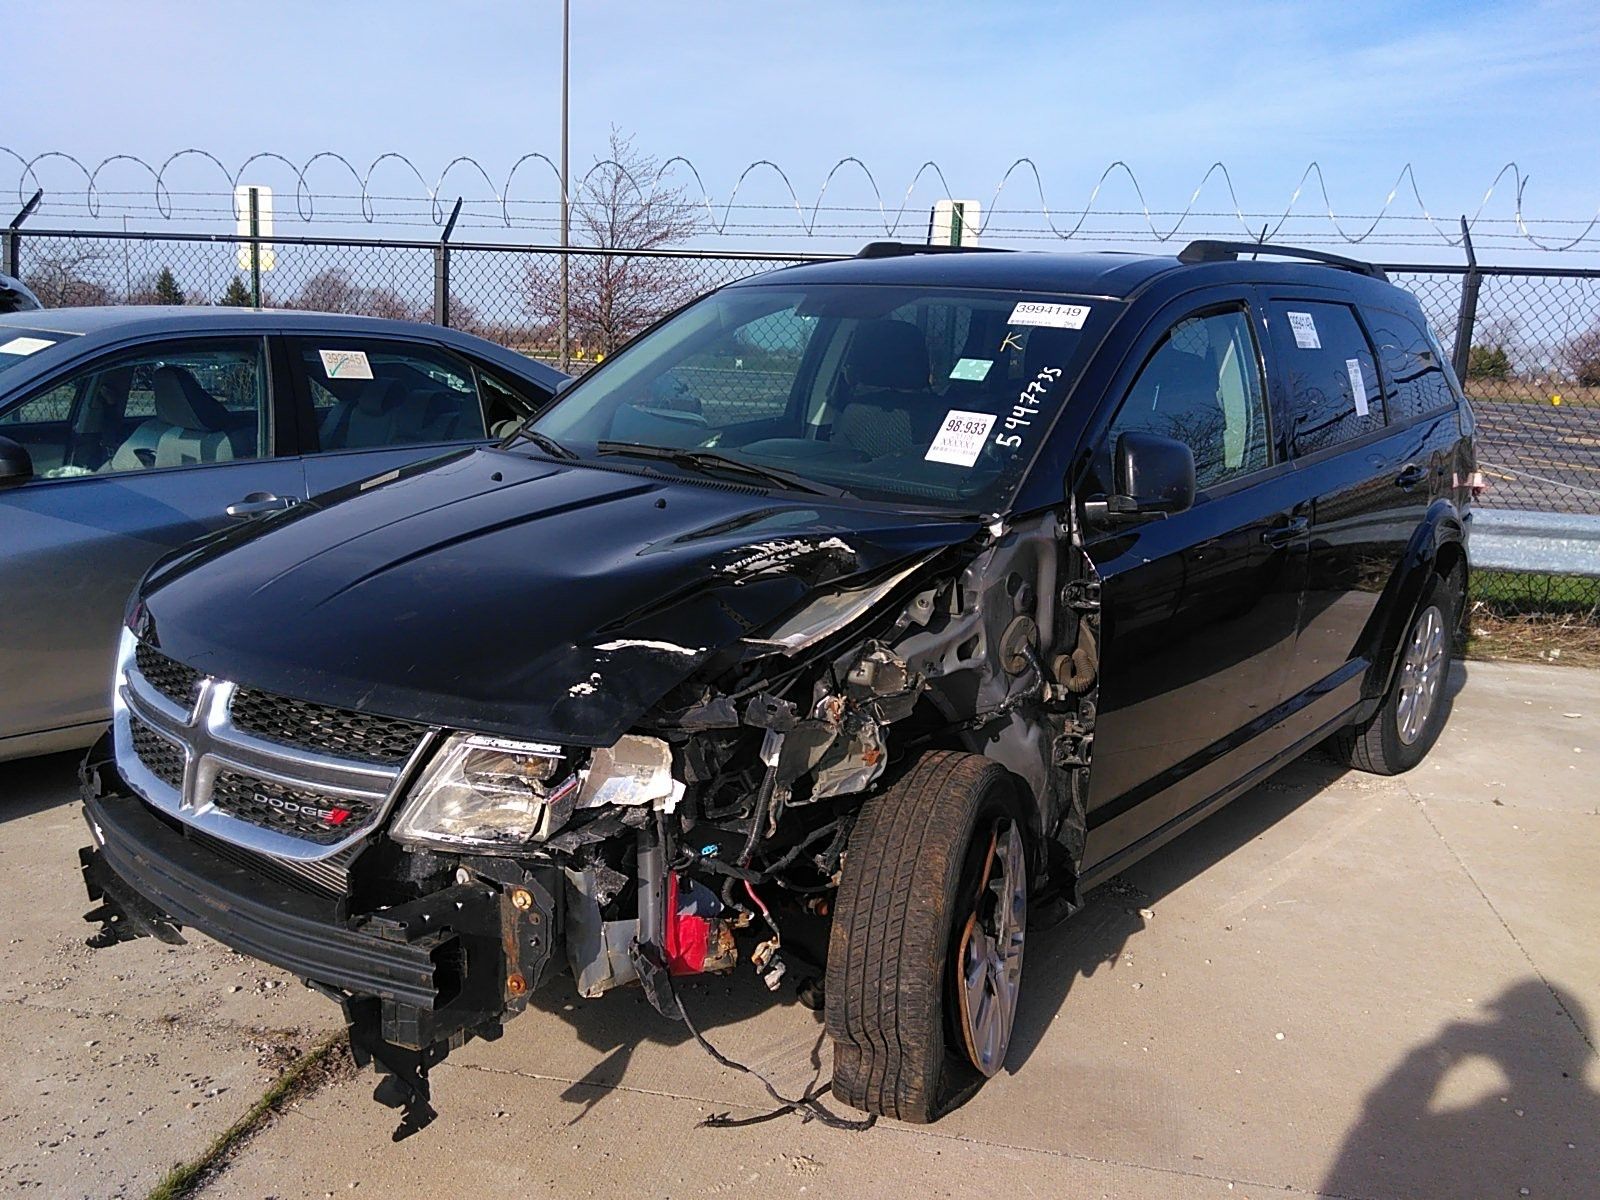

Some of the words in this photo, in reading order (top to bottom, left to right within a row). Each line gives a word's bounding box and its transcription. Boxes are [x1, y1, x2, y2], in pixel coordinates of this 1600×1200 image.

[1016, 304, 1082, 317] 3994149
[1000, 331, 1023, 352] K
[995, 366, 1063, 448] 5447735
[946, 419, 987, 436] 98:933
[254, 793, 334, 820] DODGE
